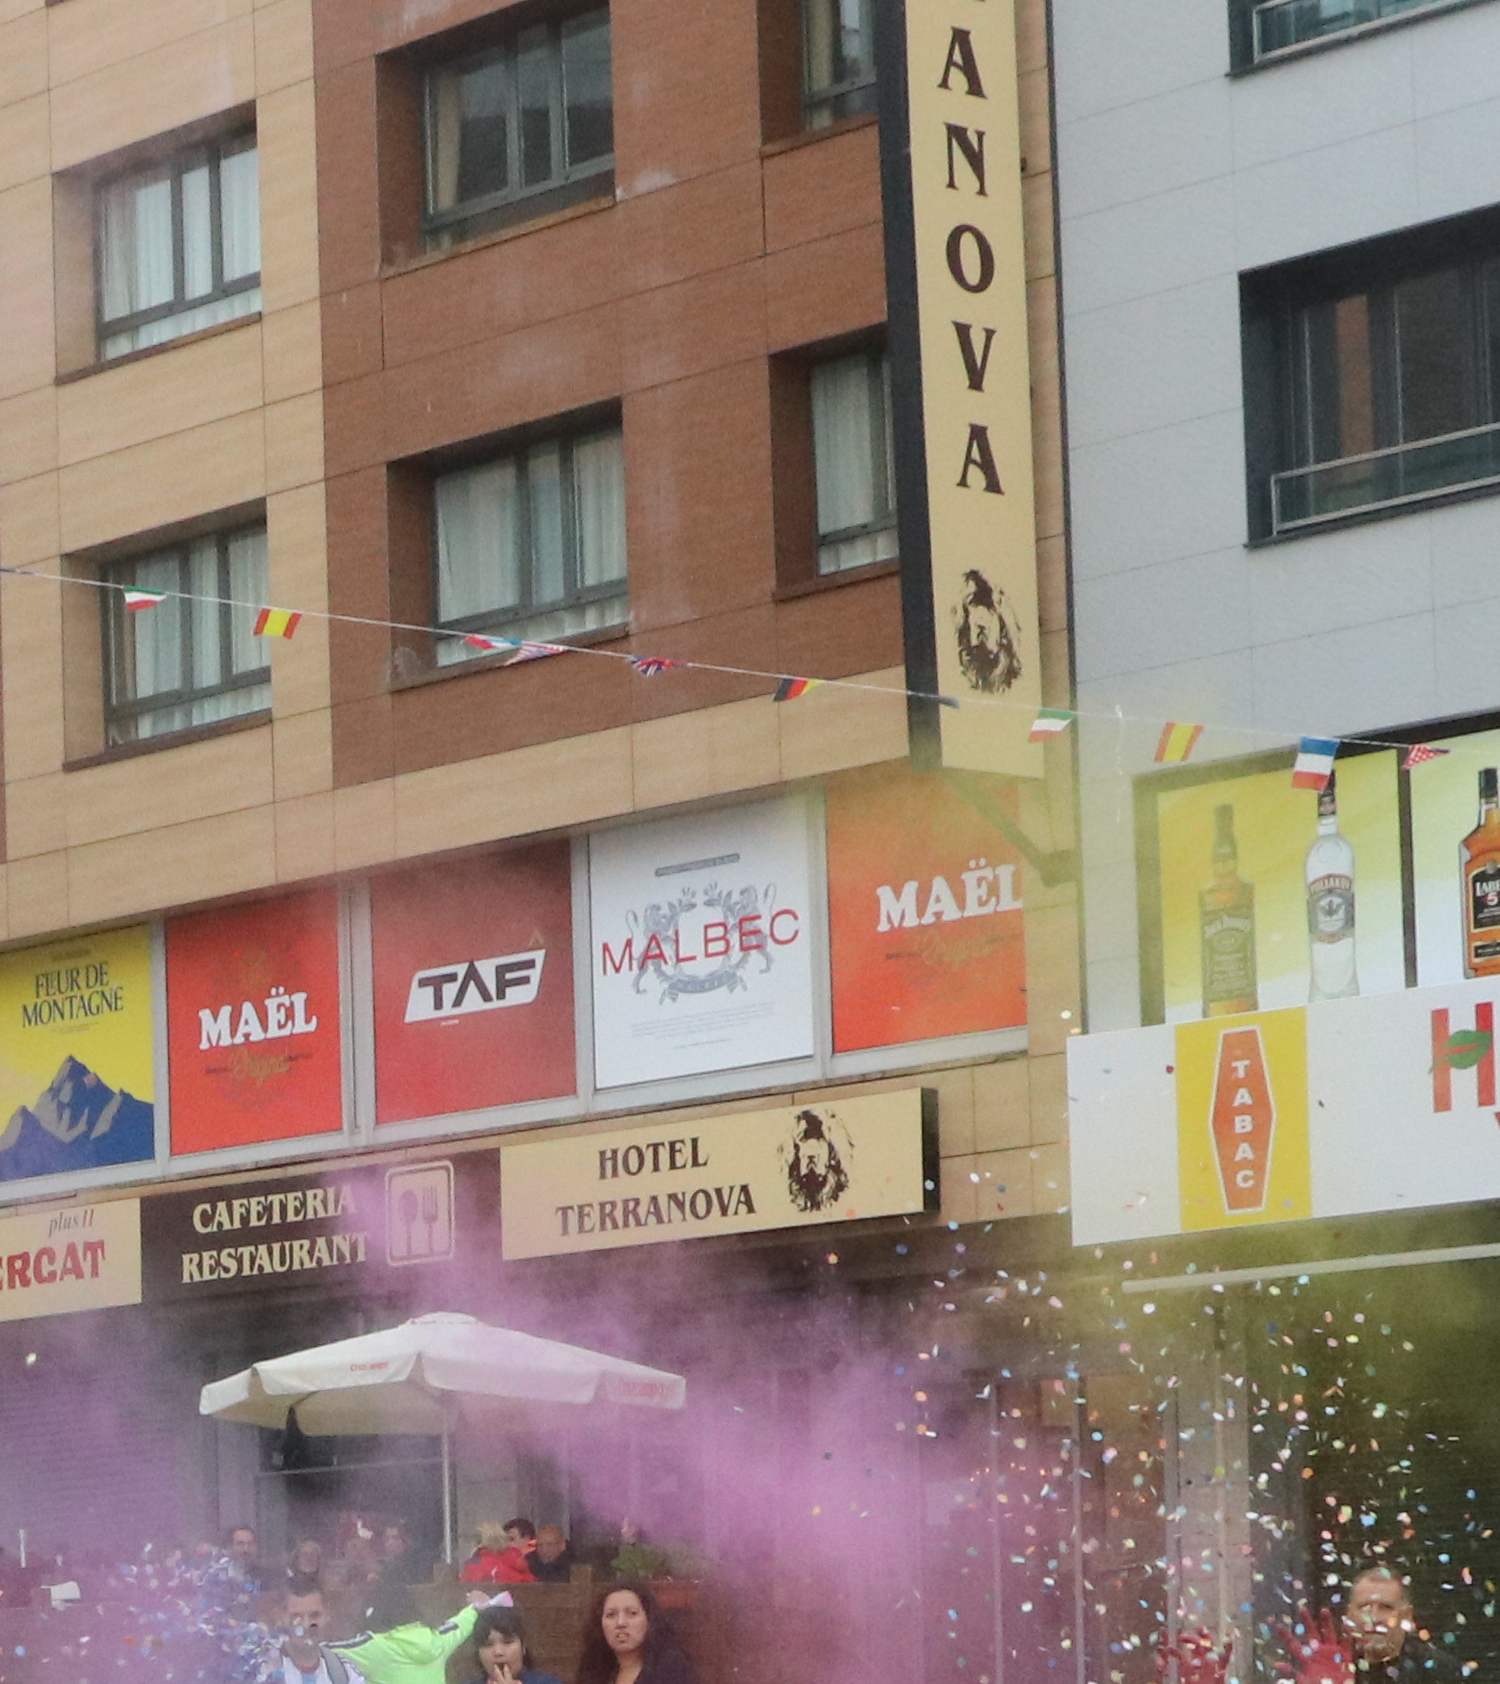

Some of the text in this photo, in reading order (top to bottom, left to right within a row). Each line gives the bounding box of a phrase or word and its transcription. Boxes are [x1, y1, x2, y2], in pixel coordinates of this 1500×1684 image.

[937, 0, 1005, 496] ANOVA
[877, 857, 1023, 932] MAËL
[1487, 891, 1498, 906] 5
[603, 909, 799, 976] MALBEC
[85, 960, 110, 988] DE
[417, 959, 536, 1011] TAF
[22, 985, 124, 1029] MONTAGNE
[199, 986, 318, 1051] MAËL
[1230, 1059, 1256, 1188] TABAC
[597, 1136, 709, 1180] HOTEL
[47, 1212, 80, 1239] plus
[191, 1186, 357, 1235] CAFETERIA
[554, 1183, 757, 1237] TERRANOVA
[181, 1231, 368, 1284] RESTAURANT
